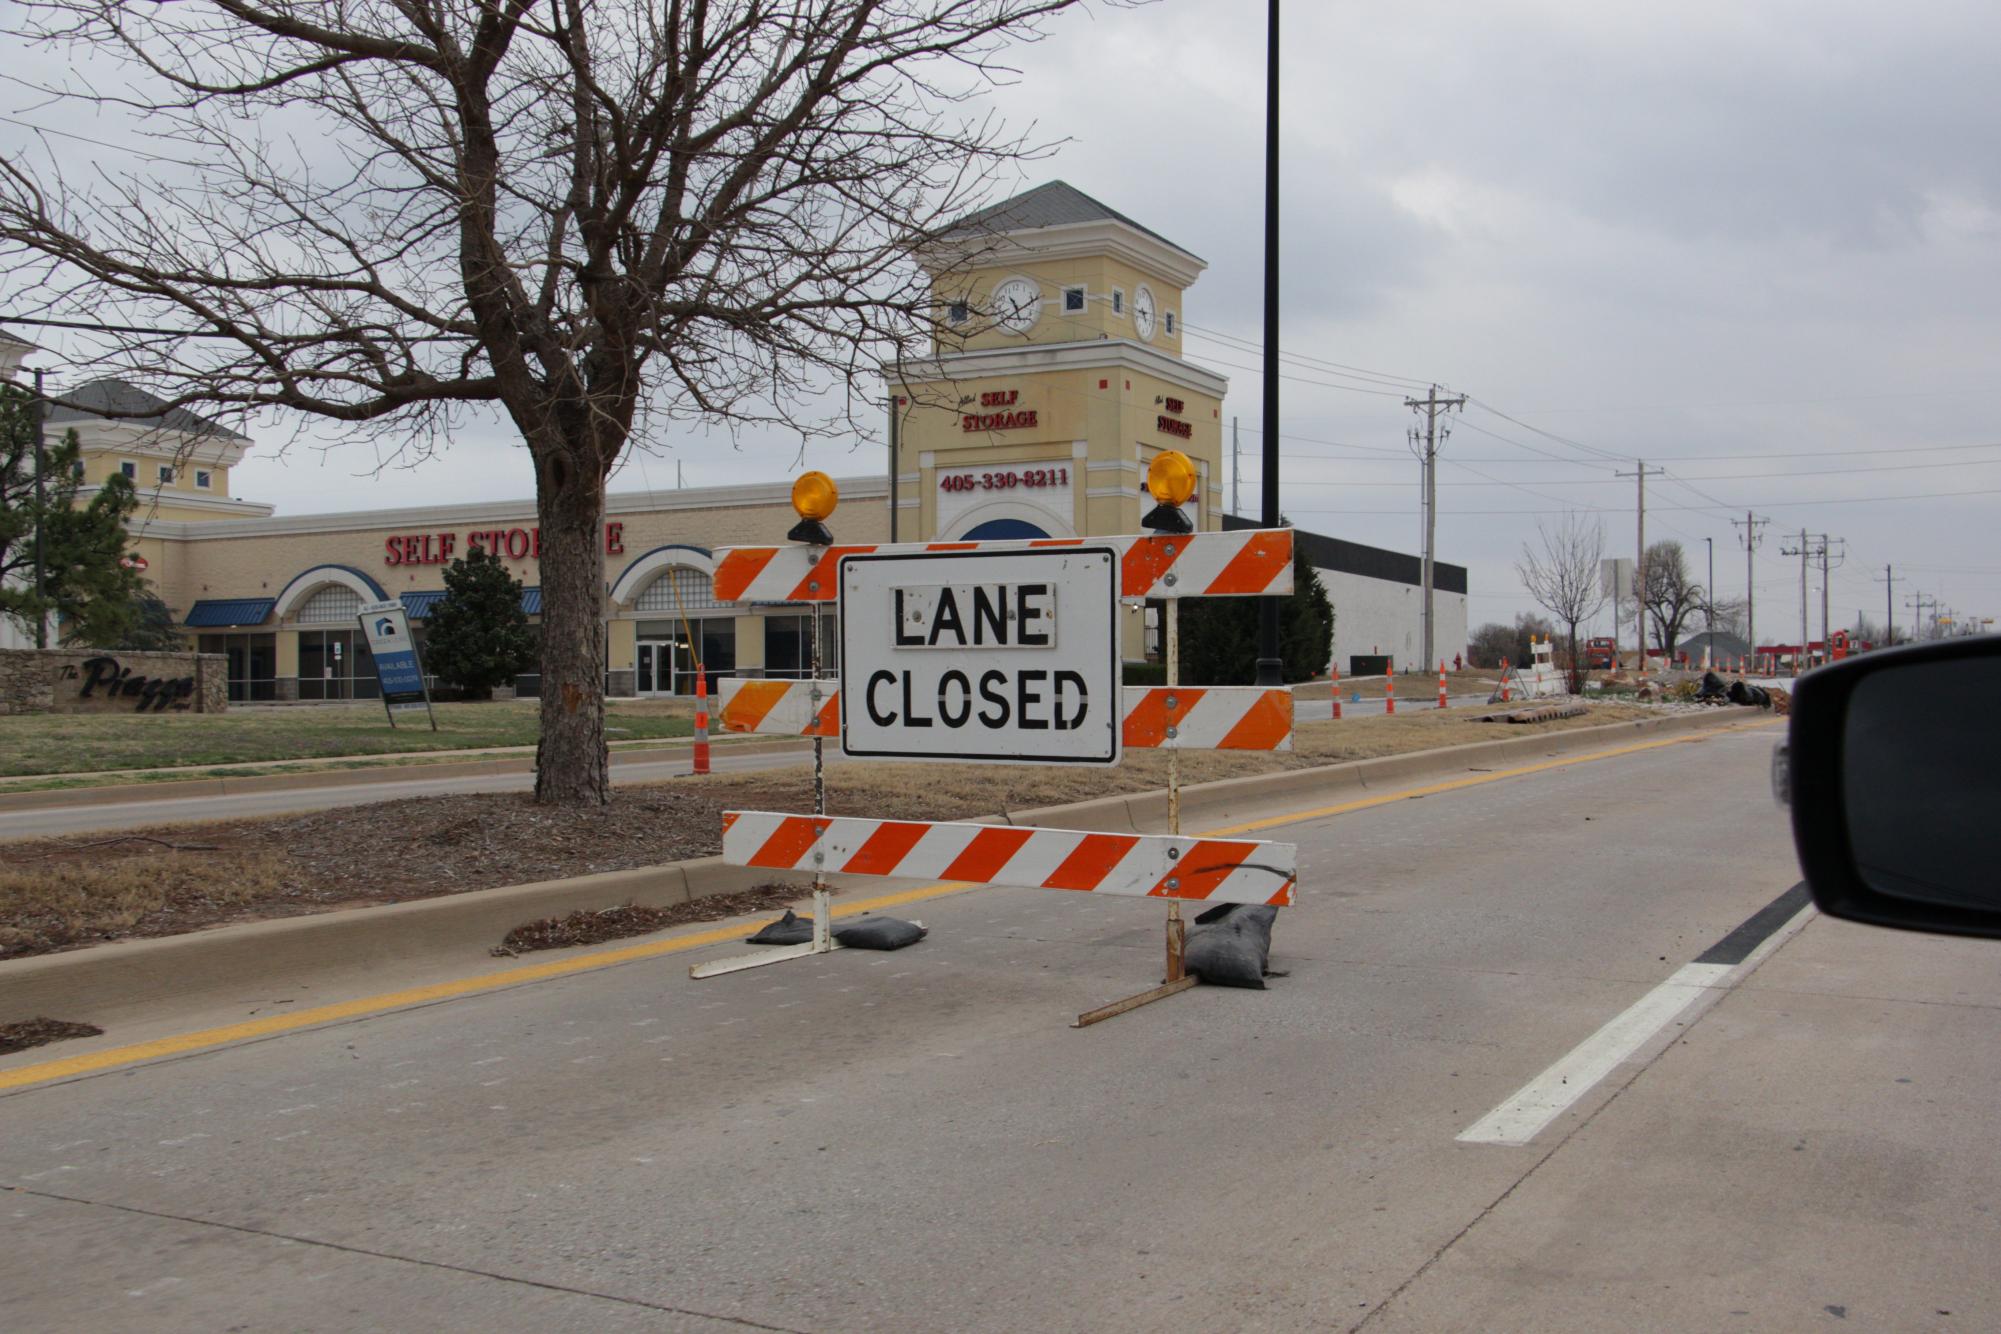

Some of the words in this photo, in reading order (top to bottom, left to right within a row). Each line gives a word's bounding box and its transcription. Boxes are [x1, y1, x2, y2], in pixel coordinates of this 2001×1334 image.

[981, 390, 1018, 407] SELF
[1165, 397, 1184, 414] SELF
[962, 410, 1038, 432] STORAGE
[940, 468, 1068, 493] 405-330-8211
[384, 532, 456, 566] SELF
[895, 584, 1048, 646] LANE
[60, 664, 79, 681] The
[866, 669, 1088, 730] CLOSED
